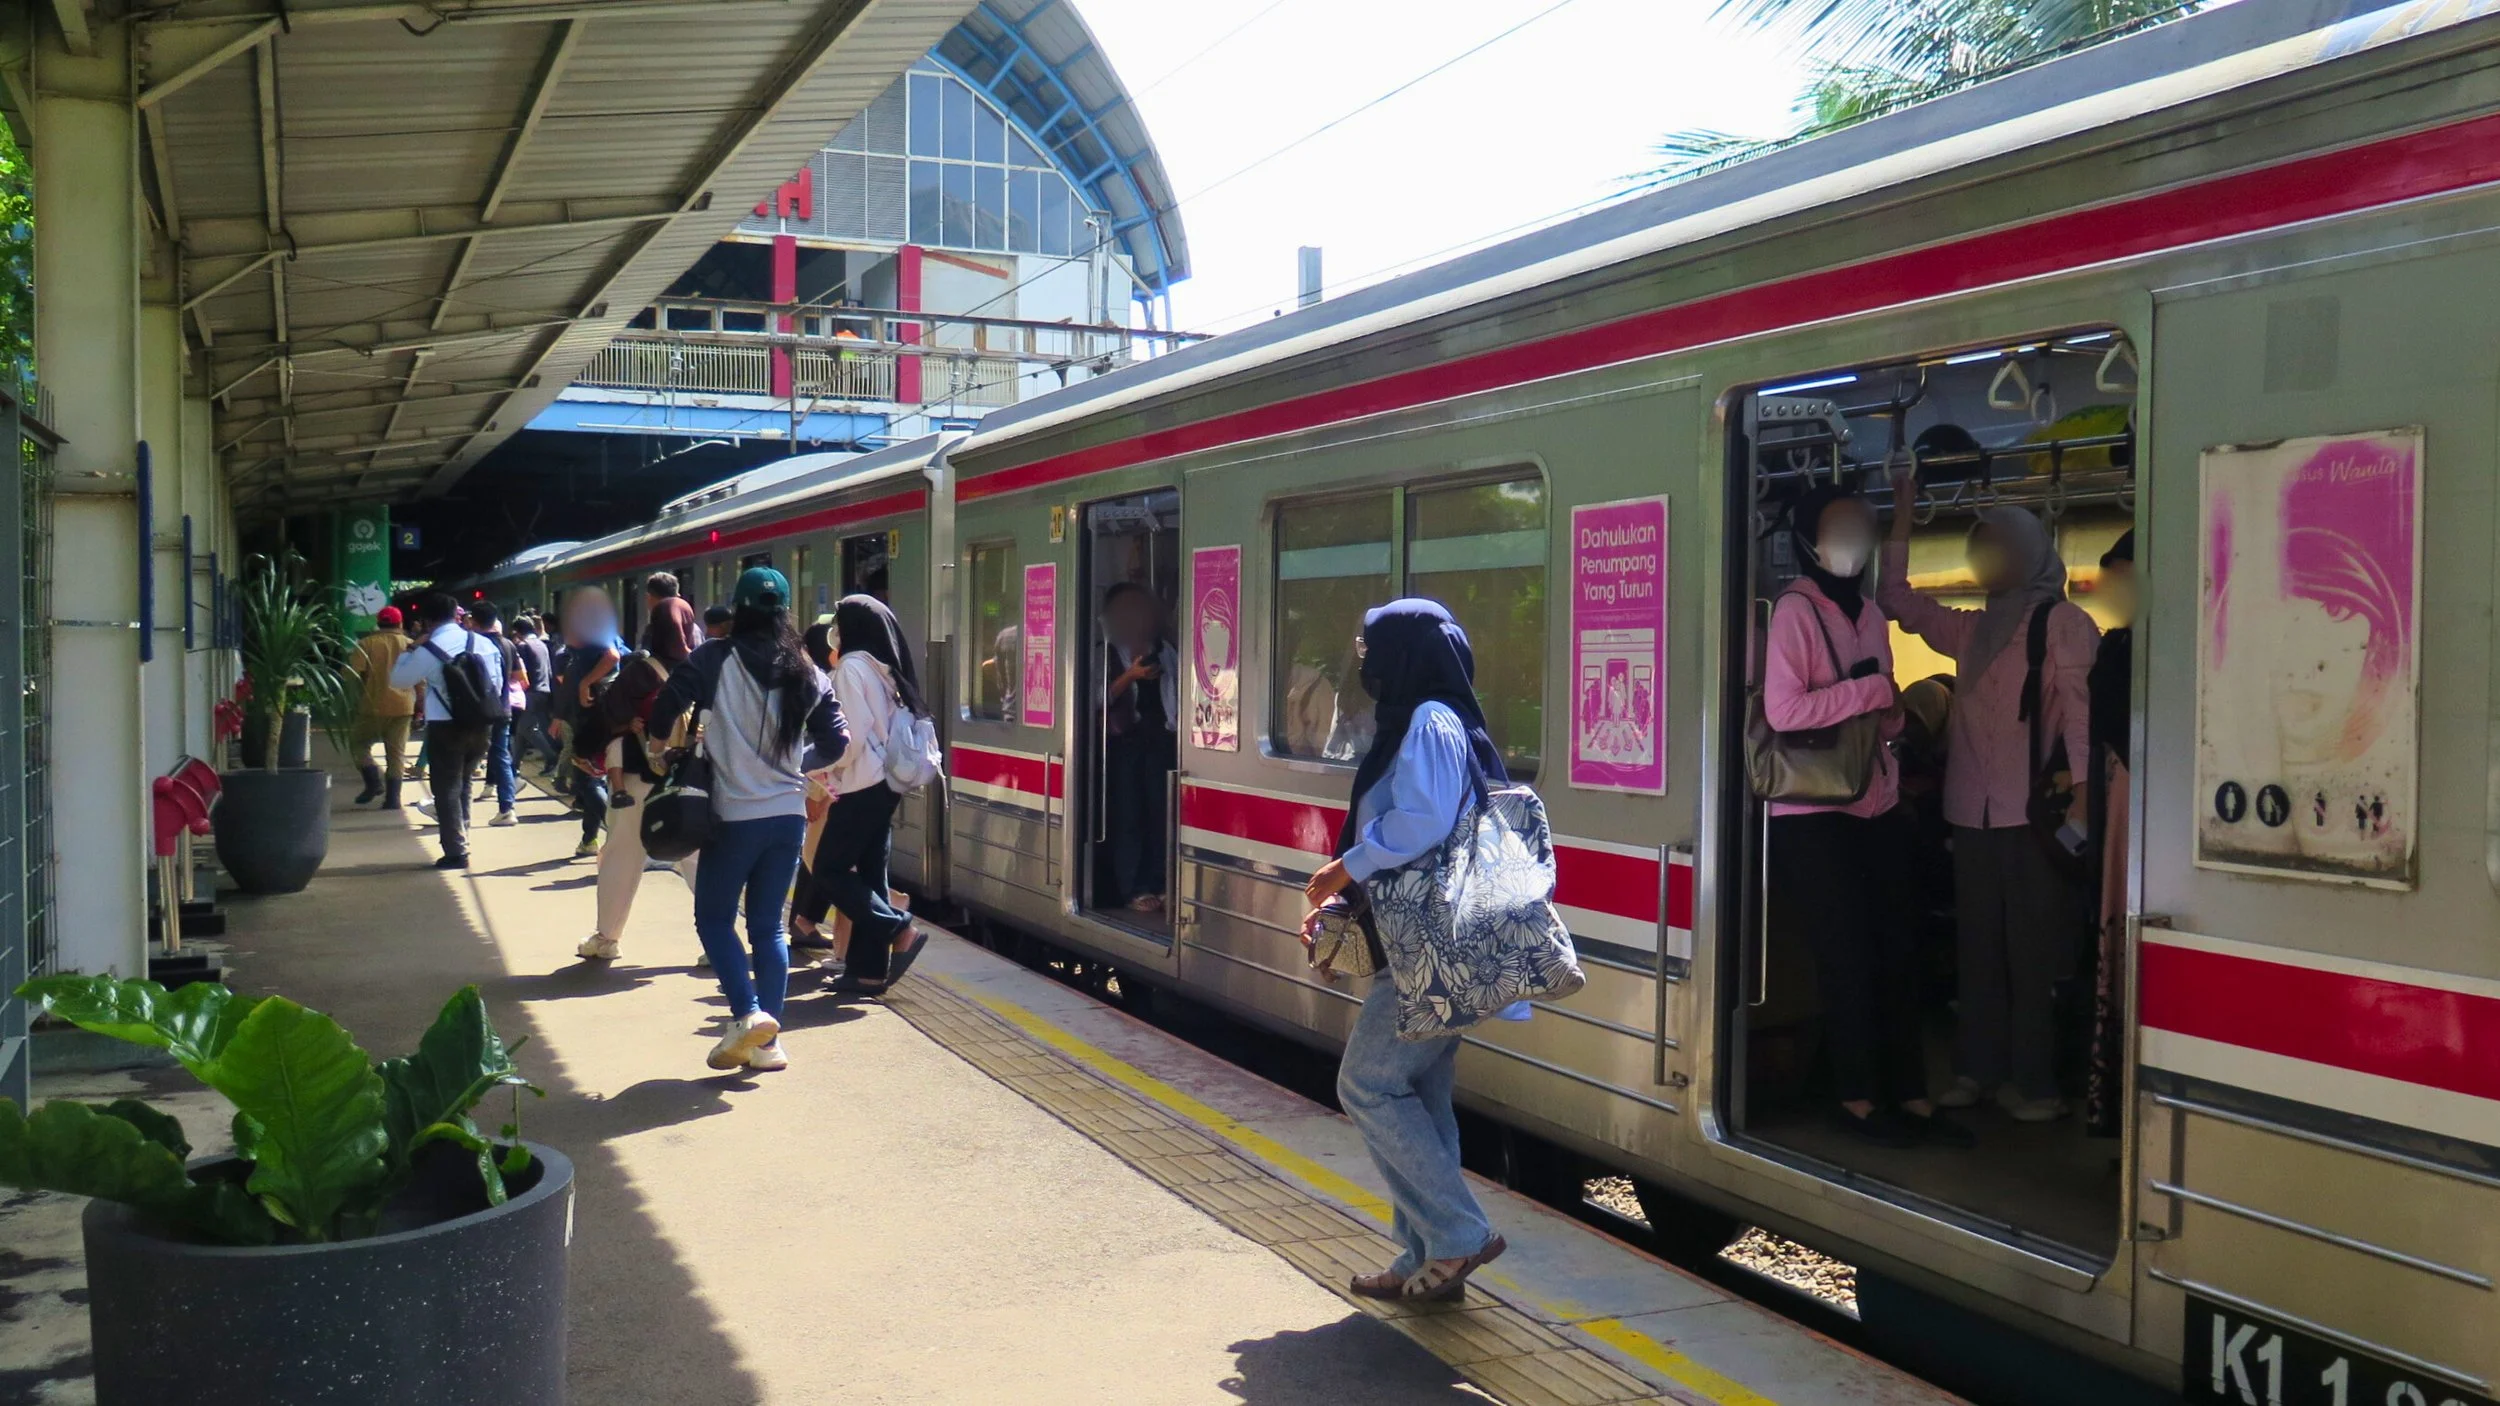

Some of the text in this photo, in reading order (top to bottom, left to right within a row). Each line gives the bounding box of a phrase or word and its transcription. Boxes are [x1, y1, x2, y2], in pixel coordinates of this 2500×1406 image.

[347, 541, 381, 554] gojek
[403, 533, 414, 545] 2
[1581, 522, 1656, 549] Dahulukan
[1581, 554, 1656, 576] Penumpang
[1582, 579, 1653, 605] Yang Turun
[2211, 1313, 2283, 1406] K1
